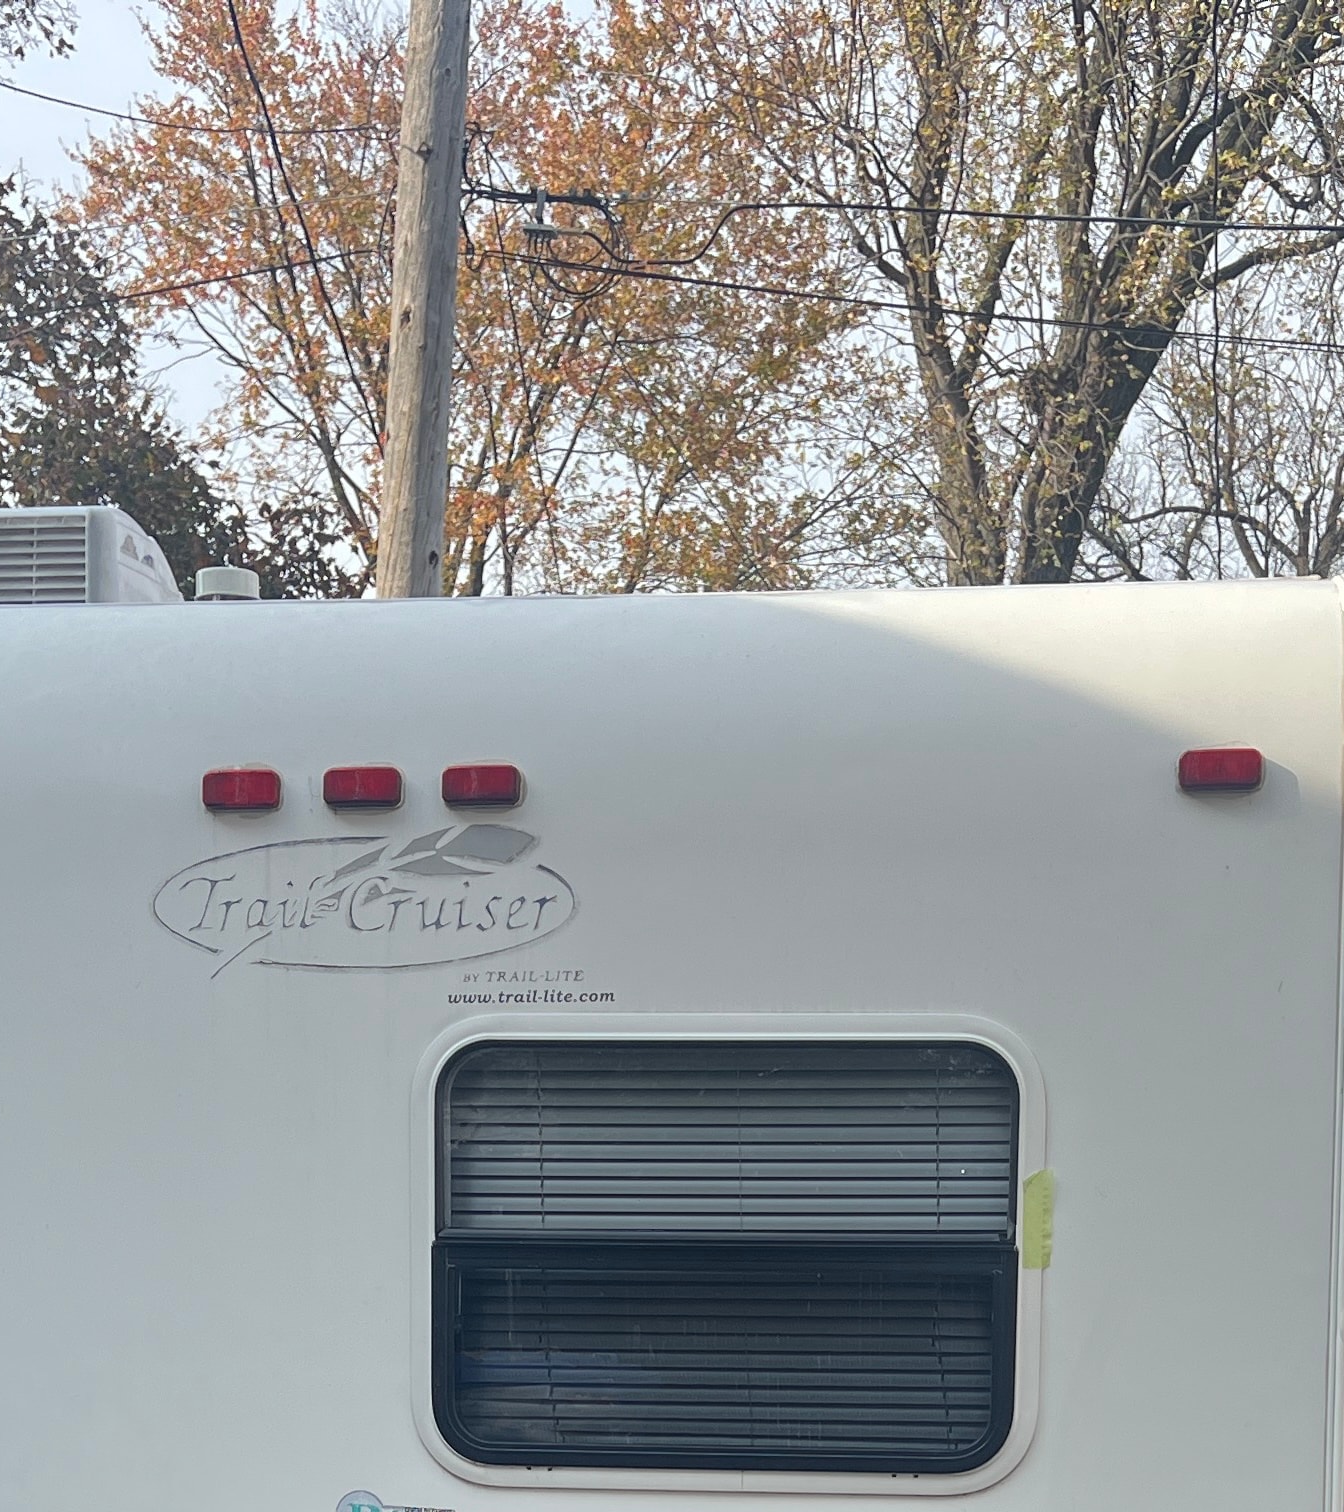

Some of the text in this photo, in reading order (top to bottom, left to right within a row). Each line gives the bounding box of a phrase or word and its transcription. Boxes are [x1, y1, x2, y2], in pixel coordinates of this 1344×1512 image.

[349, 875, 558, 932] Cruiser
[463, 970, 585, 983] BY TRAIL-LITE
[447, 989, 615, 1004] www.trail-lite.com
